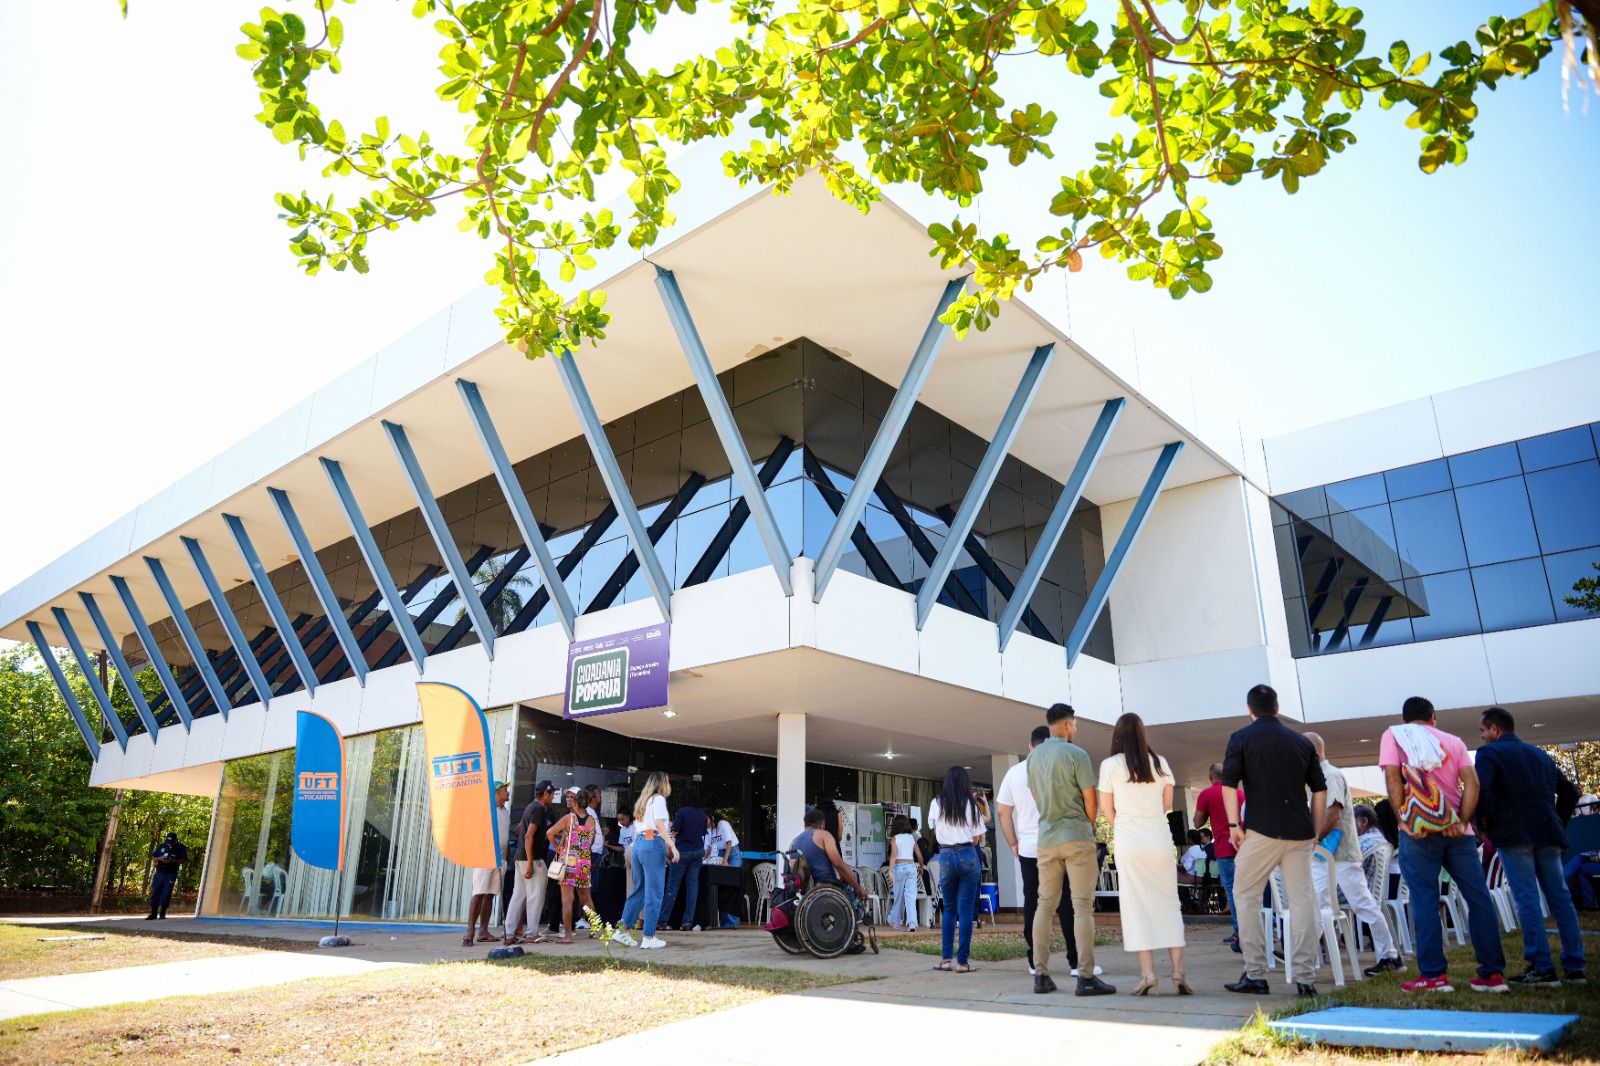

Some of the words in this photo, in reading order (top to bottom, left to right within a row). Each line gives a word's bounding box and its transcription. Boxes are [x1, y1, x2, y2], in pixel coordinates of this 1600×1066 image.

[577, 658, 621, 684] CIDADANIA
[575, 677, 621, 703] POPRUA
[305, 777, 332, 788] UFT
